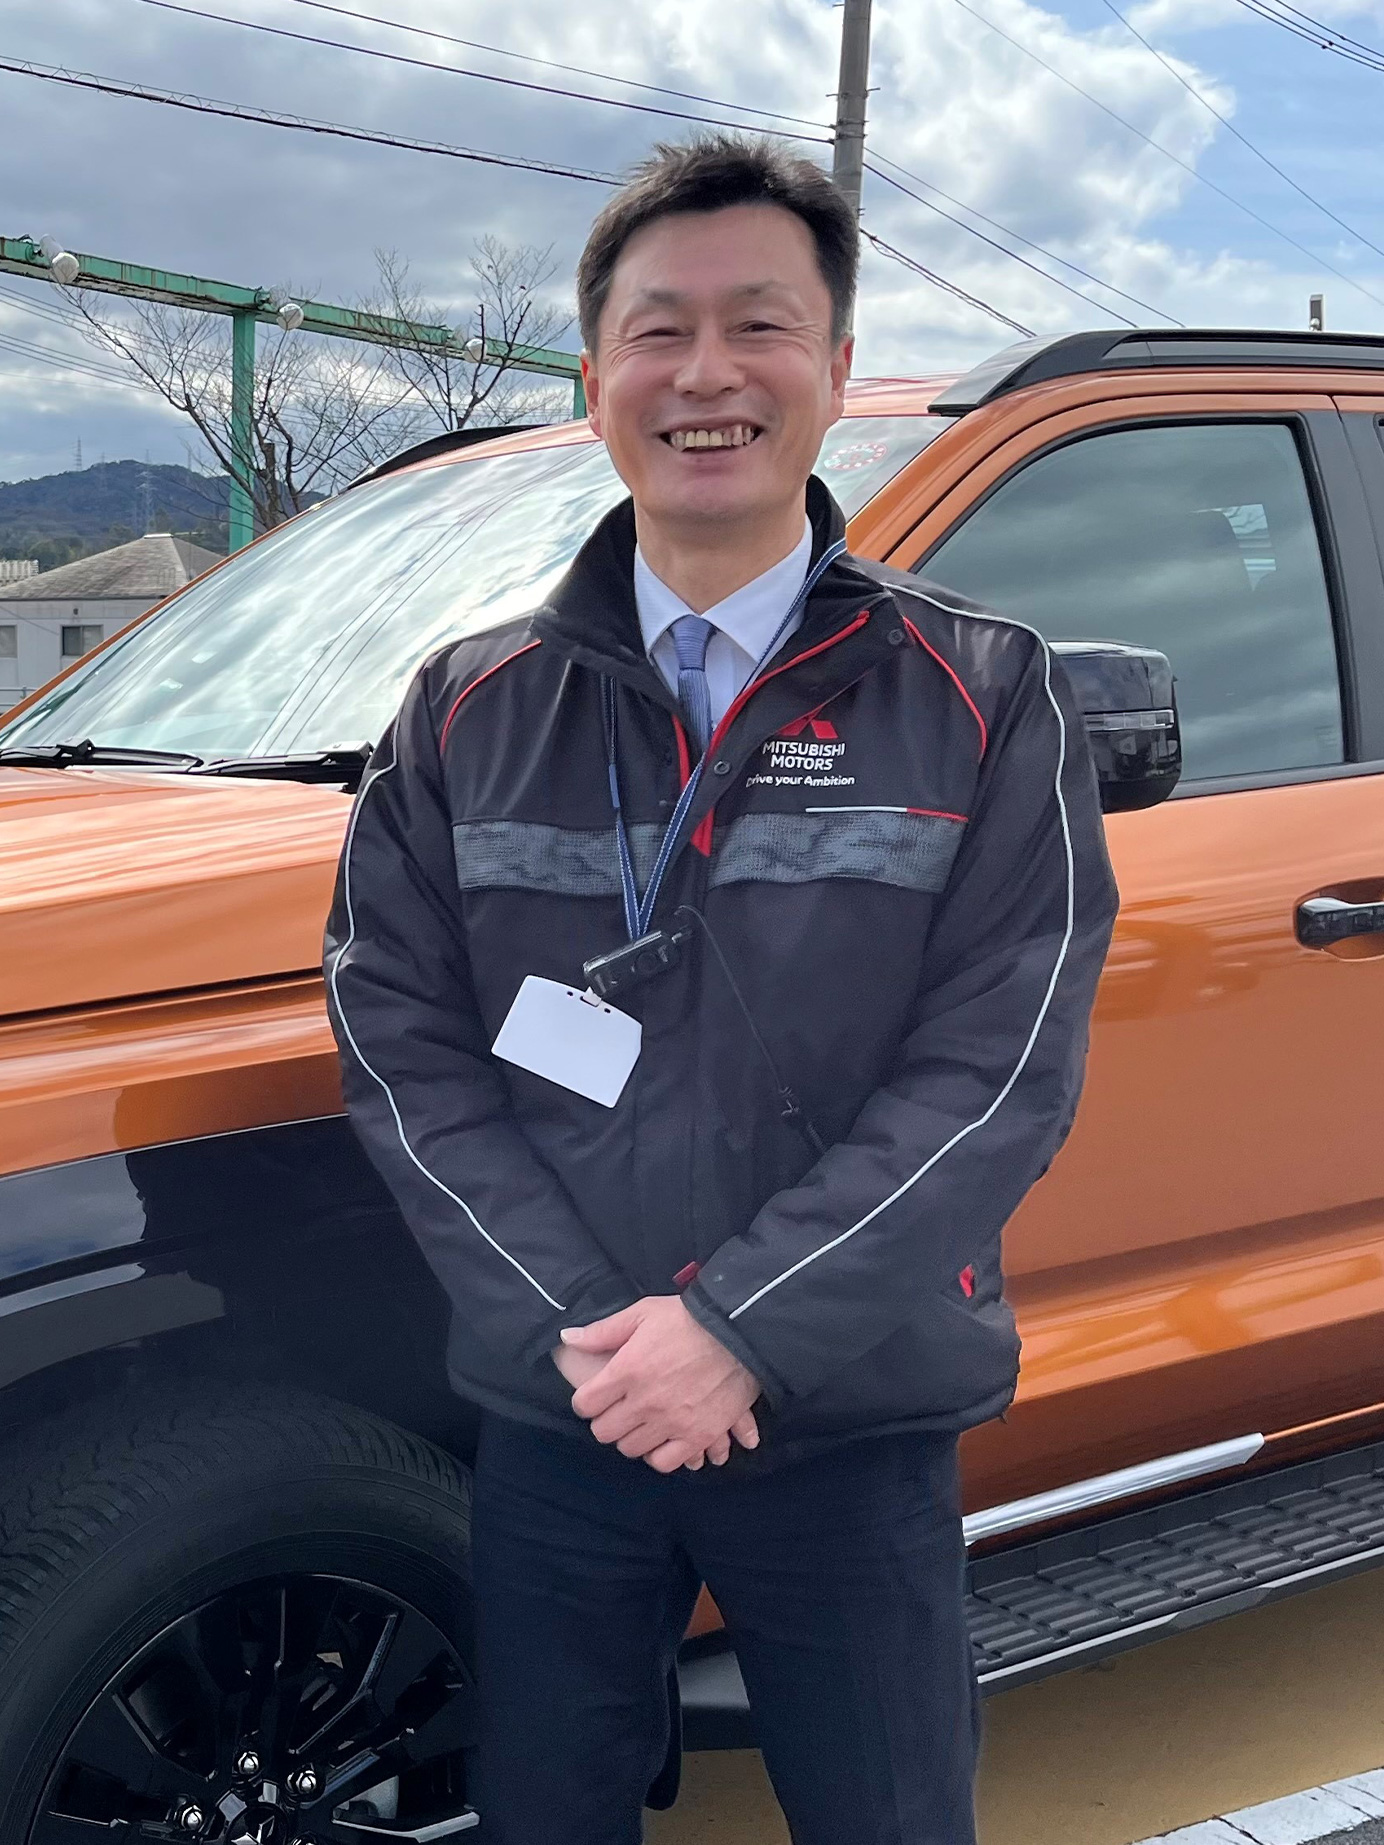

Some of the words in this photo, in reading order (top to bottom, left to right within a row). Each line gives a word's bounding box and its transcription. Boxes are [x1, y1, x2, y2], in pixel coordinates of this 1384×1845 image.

[762, 741, 846, 757] MITSUBISHI
[770, 755, 834, 771] MOTORS
[775, 775, 803, 786] your
[804, 774, 855, 787] Ambition
